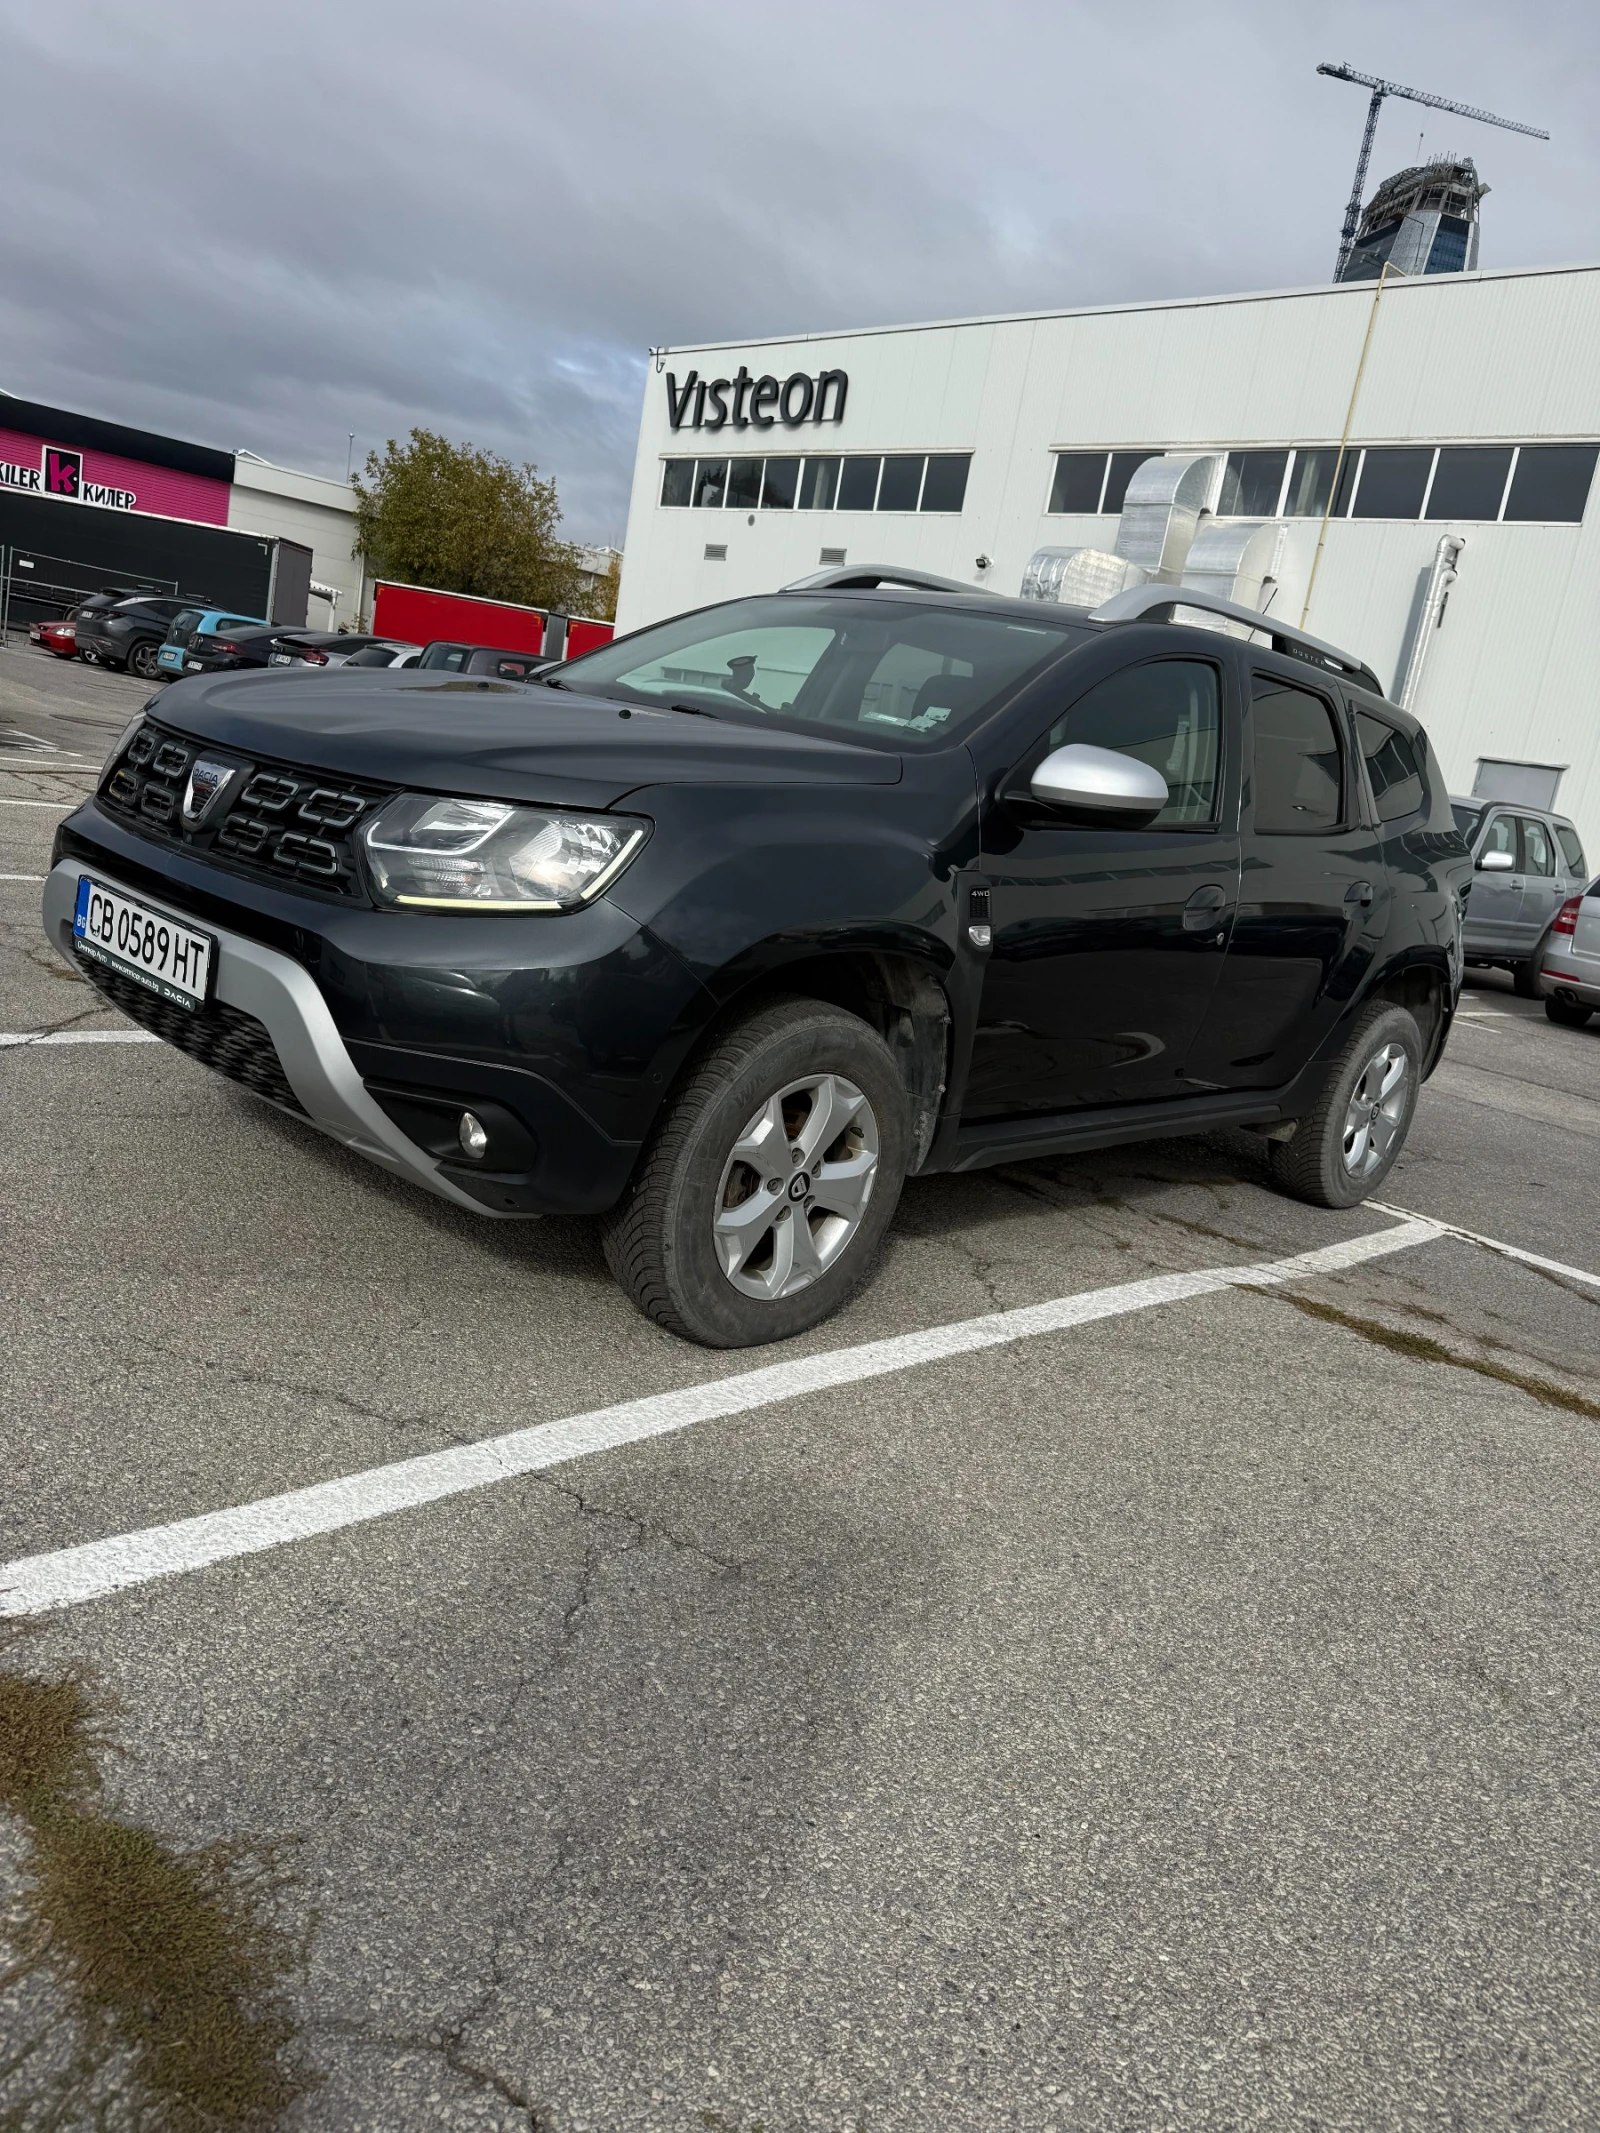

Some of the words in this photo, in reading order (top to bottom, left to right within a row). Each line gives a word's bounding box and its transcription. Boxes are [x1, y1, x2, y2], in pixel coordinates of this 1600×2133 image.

[666, 366, 849, 428] Visteon
[83, 483, 135, 509] КИЛЕР
[1292, 648, 1325, 665] DUSTER
[193, 768, 218, 785] DACIA
[76, 914, 86, 928] BG
[163, 987, 191, 1008] DACIA
